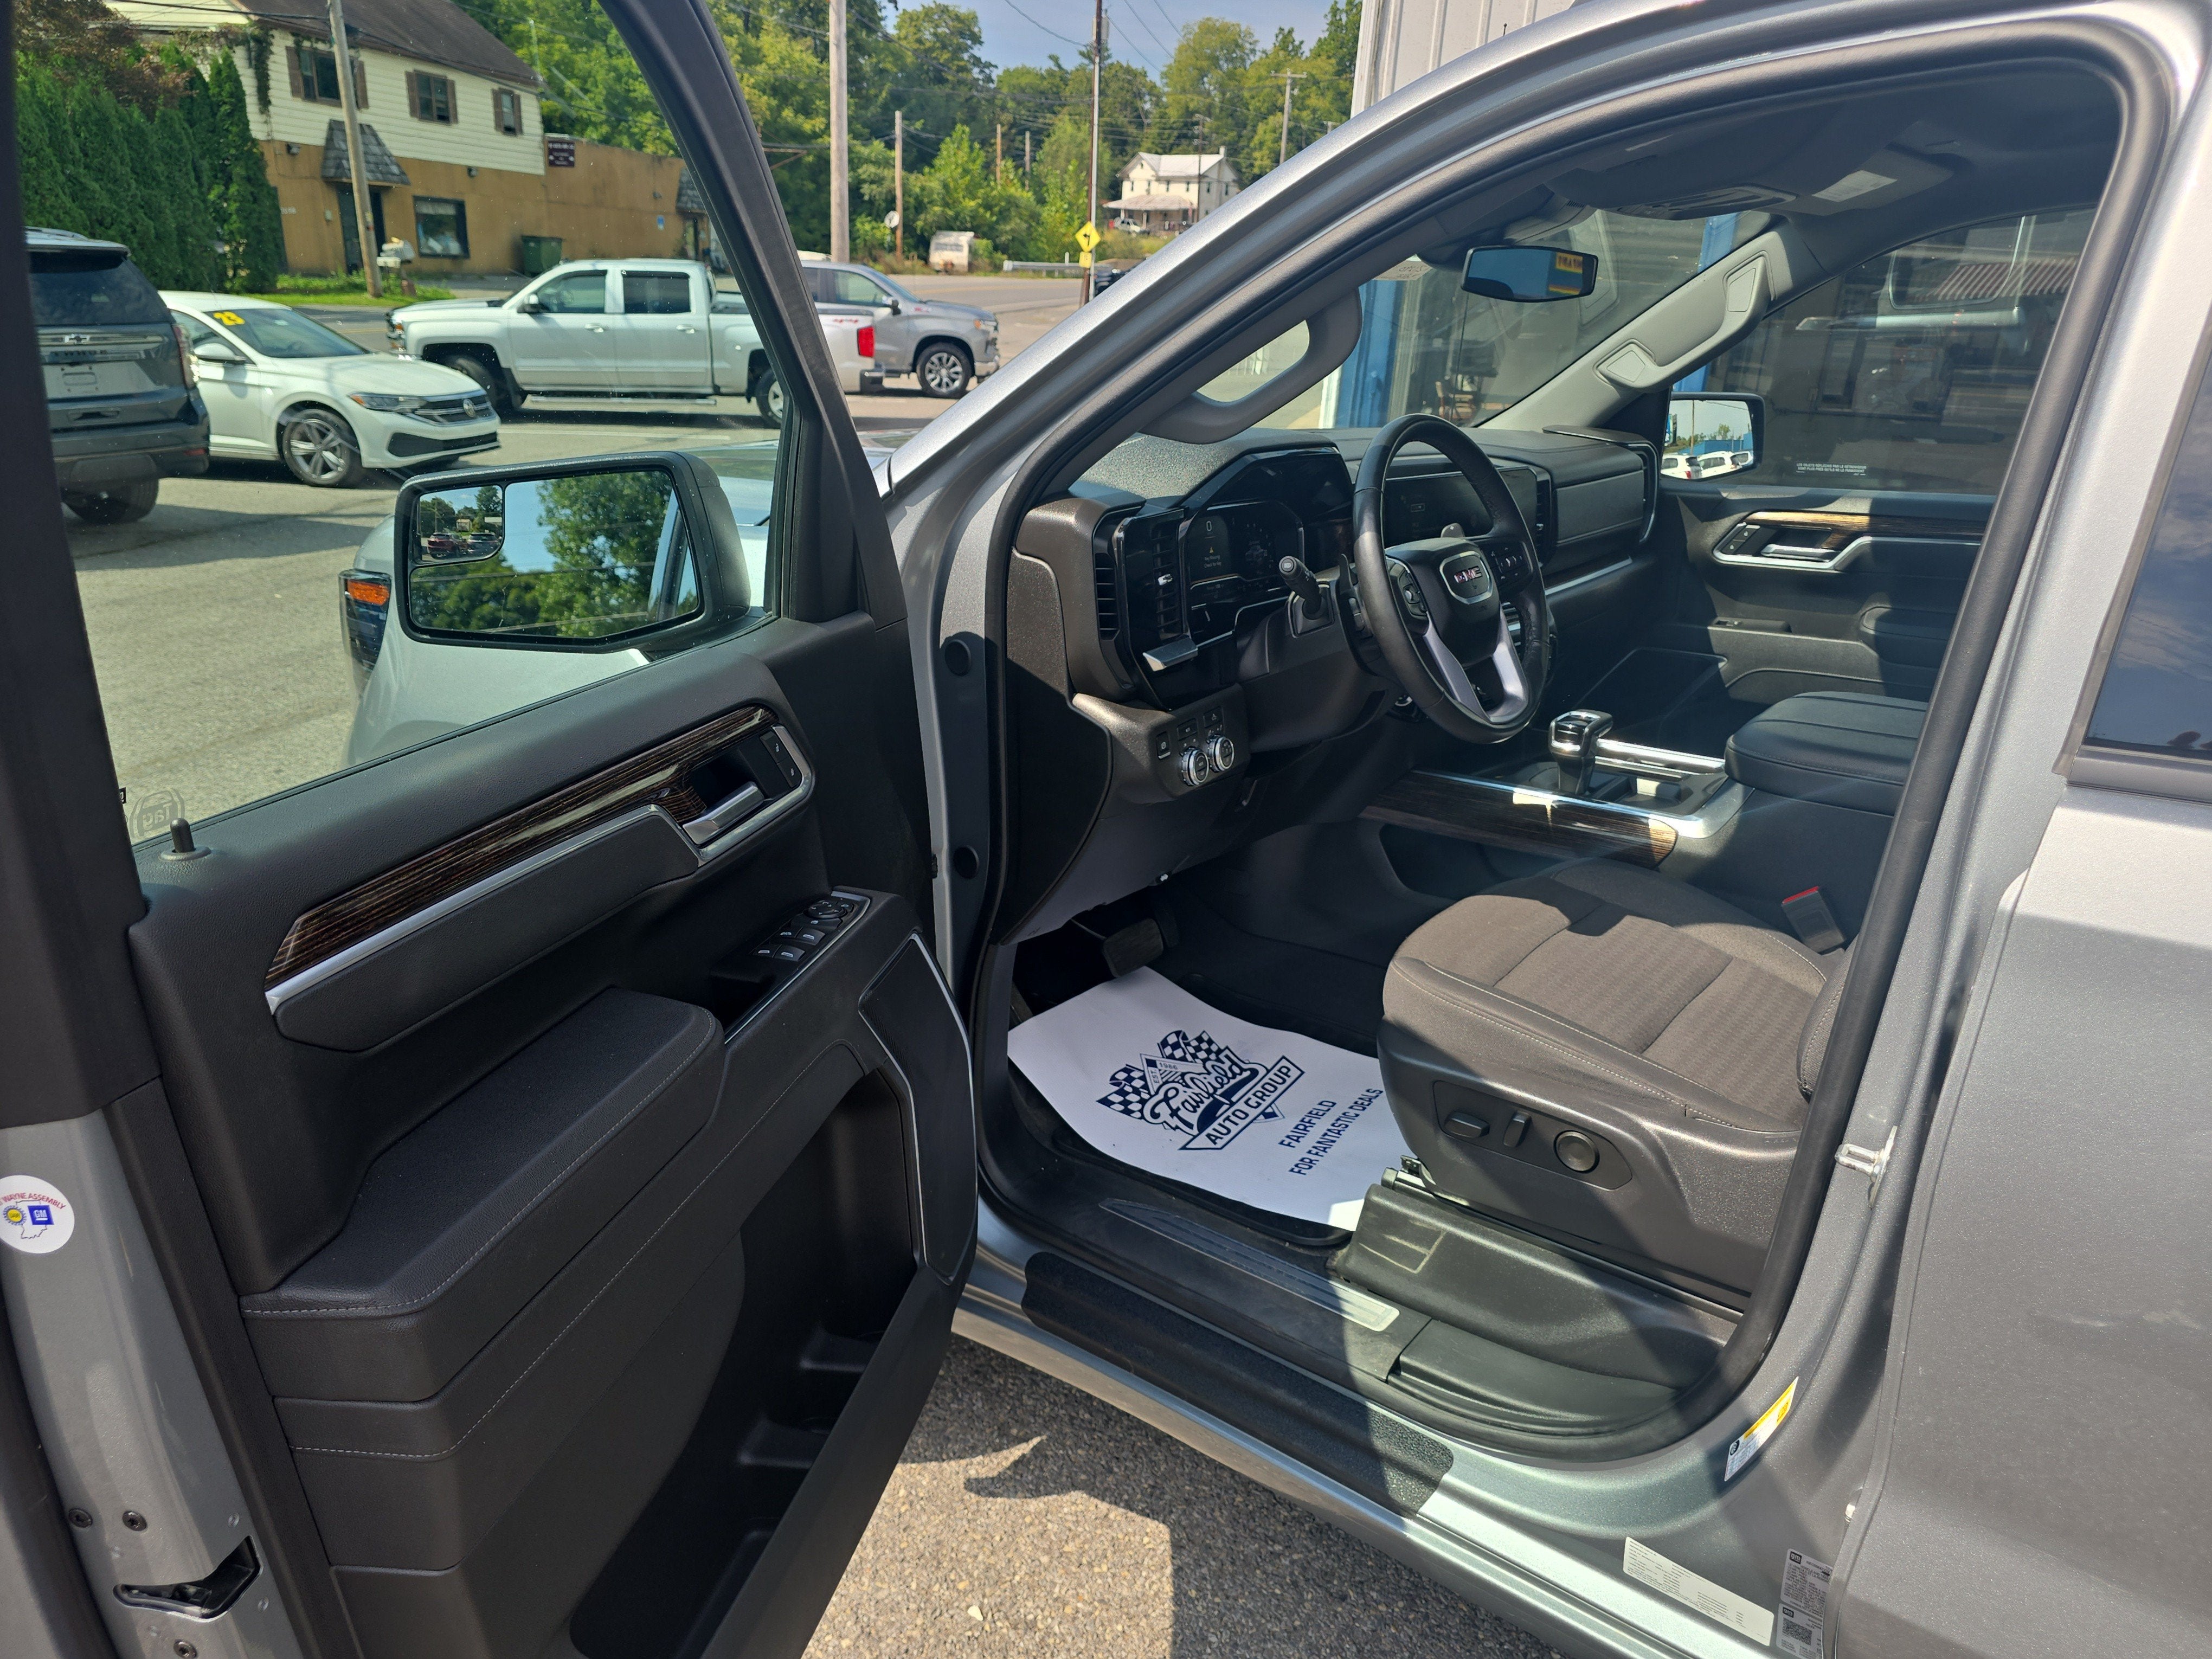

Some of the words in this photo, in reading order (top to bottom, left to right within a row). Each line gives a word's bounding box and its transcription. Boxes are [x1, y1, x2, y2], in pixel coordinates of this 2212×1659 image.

[213, 311, 246, 326] 23
[1159, 1062, 1178, 1070] 1986
[1149, 1054, 1246, 1130] Fairfield
[1205, 1109, 1249, 1145] AUTO
[1244, 1065, 1291, 1109] GROUP
[1278, 1100, 1337, 1148] FAIRFIELD
[1289, 1157, 1320, 1175] FOR
[1306, 1111, 1360, 1157] FANTASTIC
[1348, 1088, 1384, 1111] DEALS
[2, 1193, 27, 1203] WAYNE
[28, 1193, 66, 1210] ASSEMBLY
[34, 1210, 48, 1218] GM
[1791, 1553, 1801, 1561] gm
